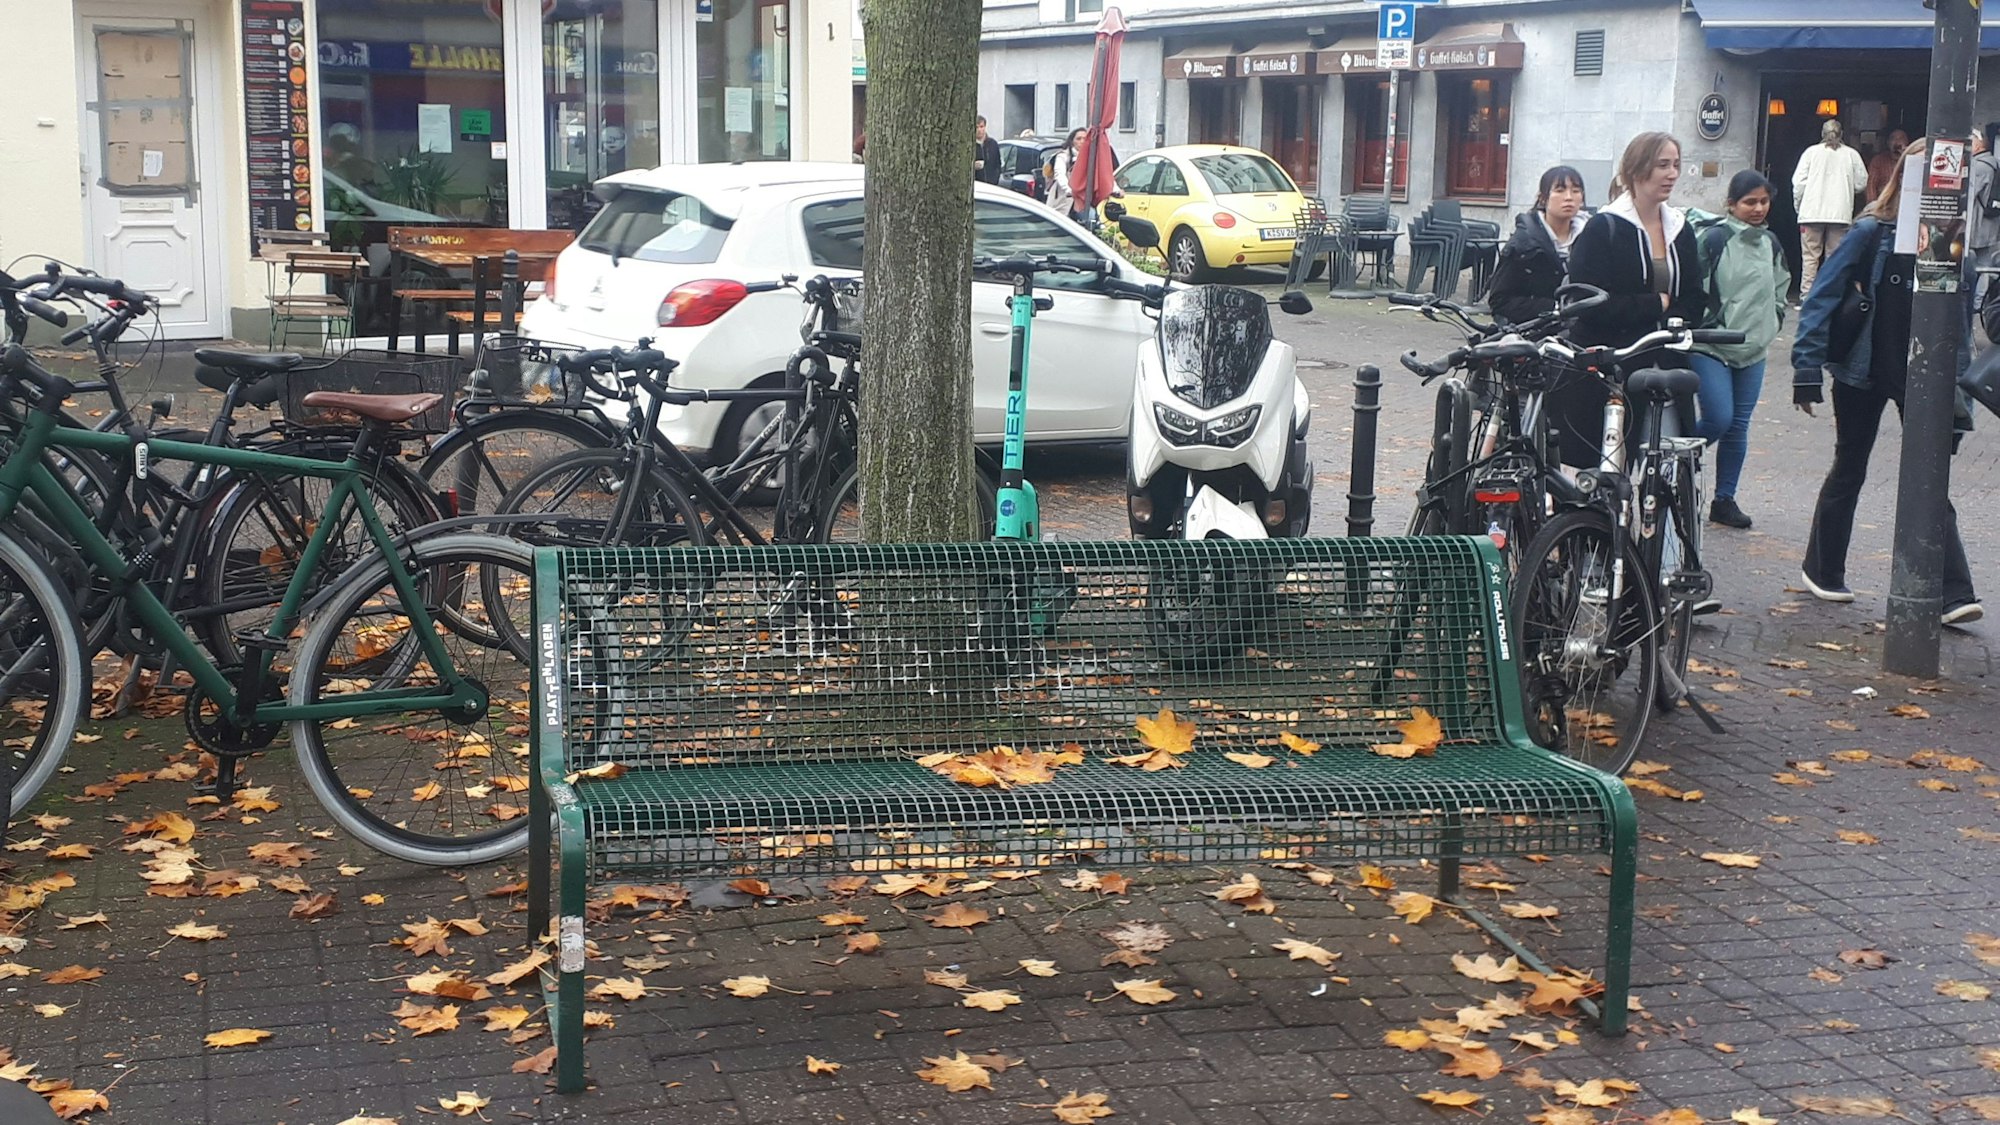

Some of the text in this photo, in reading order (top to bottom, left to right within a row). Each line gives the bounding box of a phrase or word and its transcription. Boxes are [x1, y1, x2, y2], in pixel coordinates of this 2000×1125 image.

[827, 22, 835, 41] 1
[1386, 8, 1407, 38] P
[1701, 109, 1724, 120] Gaffel
[1005, 395, 1021, 465] TIER
[542, 623, 560, 726] PLATTENLADEN
